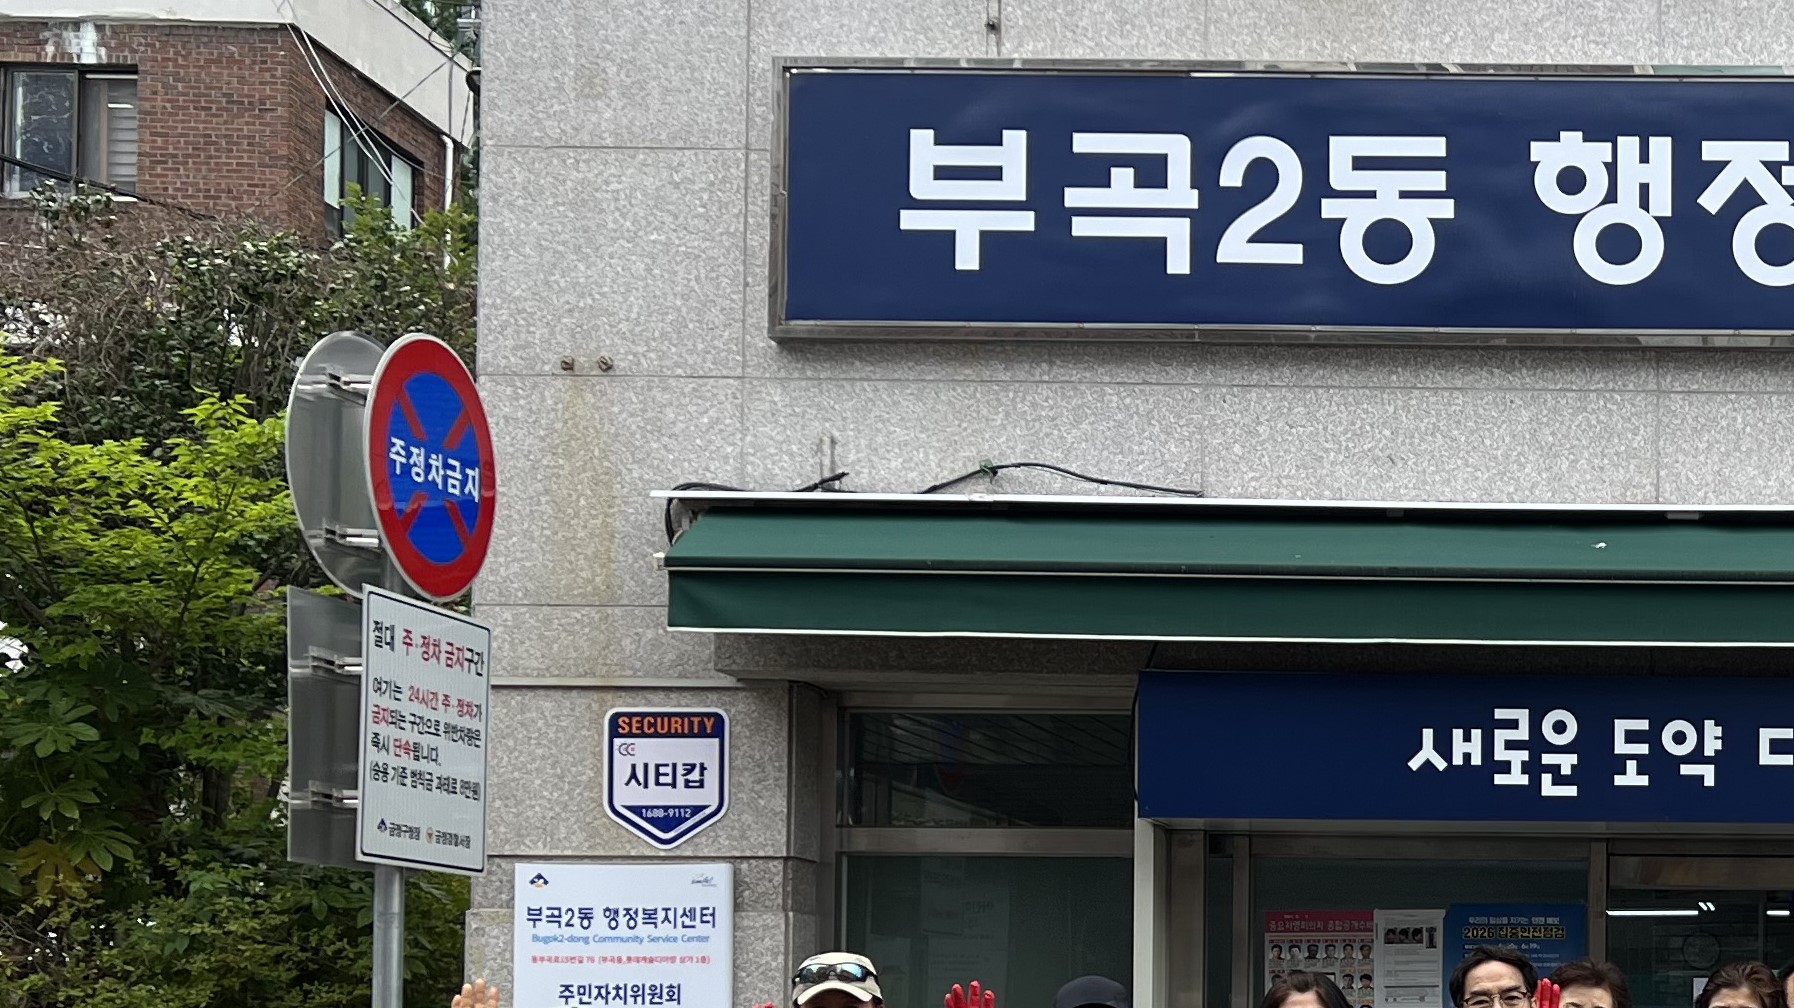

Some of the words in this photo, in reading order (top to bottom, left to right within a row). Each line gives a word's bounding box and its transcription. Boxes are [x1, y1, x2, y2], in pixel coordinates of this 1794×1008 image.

[899, 128, 1455, 286] 부곡2동
[389, 436, 479, 503] 주정차금지
[372, 619, 395, 652] 절대
[444, 641, 485, 677] 금지구간
[372, 677, 403, 701] 여기는
[408, 685, 439, 711] 24시간
[372, 703, 407, 731] 금지되는
[408, 712, 442, 738] 구간으로
[618, 716, 714, 734] SECURITY
[371, 732, 390, 755] 즉시
[393, 738, 441, 766] 단속됩니다.
[1407, 708, 1578, 797] 새로운
[1613, 719, 1723, 787] 도약
[624, 762, 707, 789] 시티캅
[526, 906, 594, 930] 부곡2동
[602, 906, 717, 931] 행정복지센터
[1463, 927, 1495, 939] 2026
[592, 934, 644, 945] Community
[647, 934, 678, 943] Service
[680, 934, 710, 943] Center
[558, 983, 682, 1006] 주민자치위원회
